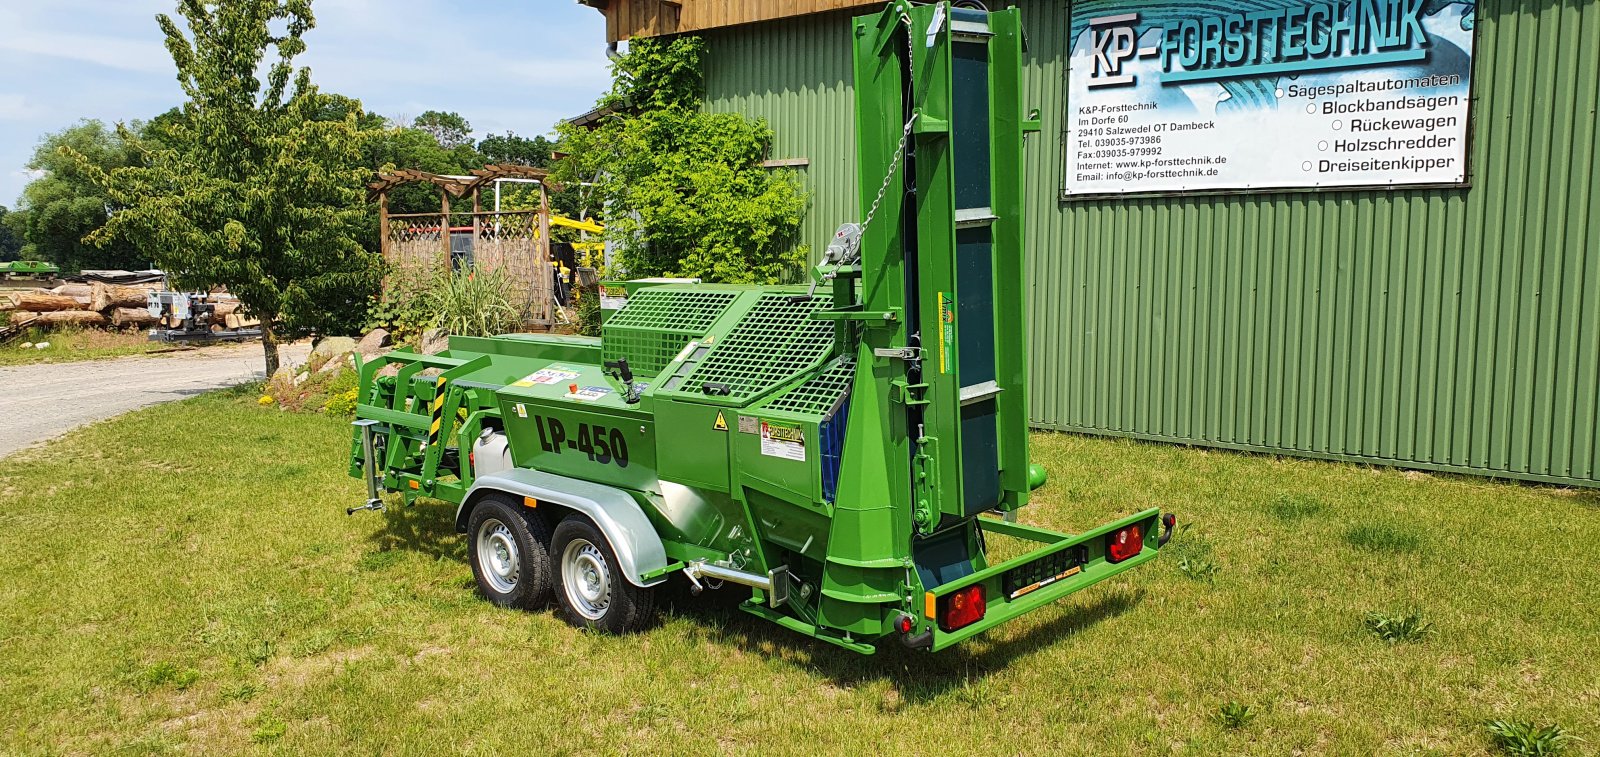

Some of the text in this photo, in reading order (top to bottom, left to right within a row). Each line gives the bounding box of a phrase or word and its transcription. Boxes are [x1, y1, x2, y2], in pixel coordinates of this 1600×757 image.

[1090, 0, 1427, 77] KP-FORSTTECHNIK
[1288, 74, 1460, 99] Sägespaltautomaten
[1078, 102, 1158, 114] K&P-Forsttechnik
[1322, 95, 1458, 115] Blockbandsägen
[1078, 115, 1129, 126] Im Dorfe 60
[1078, 120, 1215, 137] 29410 Salzwedel OT Dambeck
[1350, 116, 1457, 132] Rückewagen
[1078, 135, 1162, 148] Tel. 039035-973986
[1334, 135, 1456, 153] Holzschredder
[1077, 156, 1227, 170] Internet: www.kp-forsttechnik.de
[1318, 156, 1455, 173] Dreiseitenkipper
[1076, 168, 1219, 181] Email: info@kp-forsttechnik.de
[535, 415, 629, 468] LP-450
